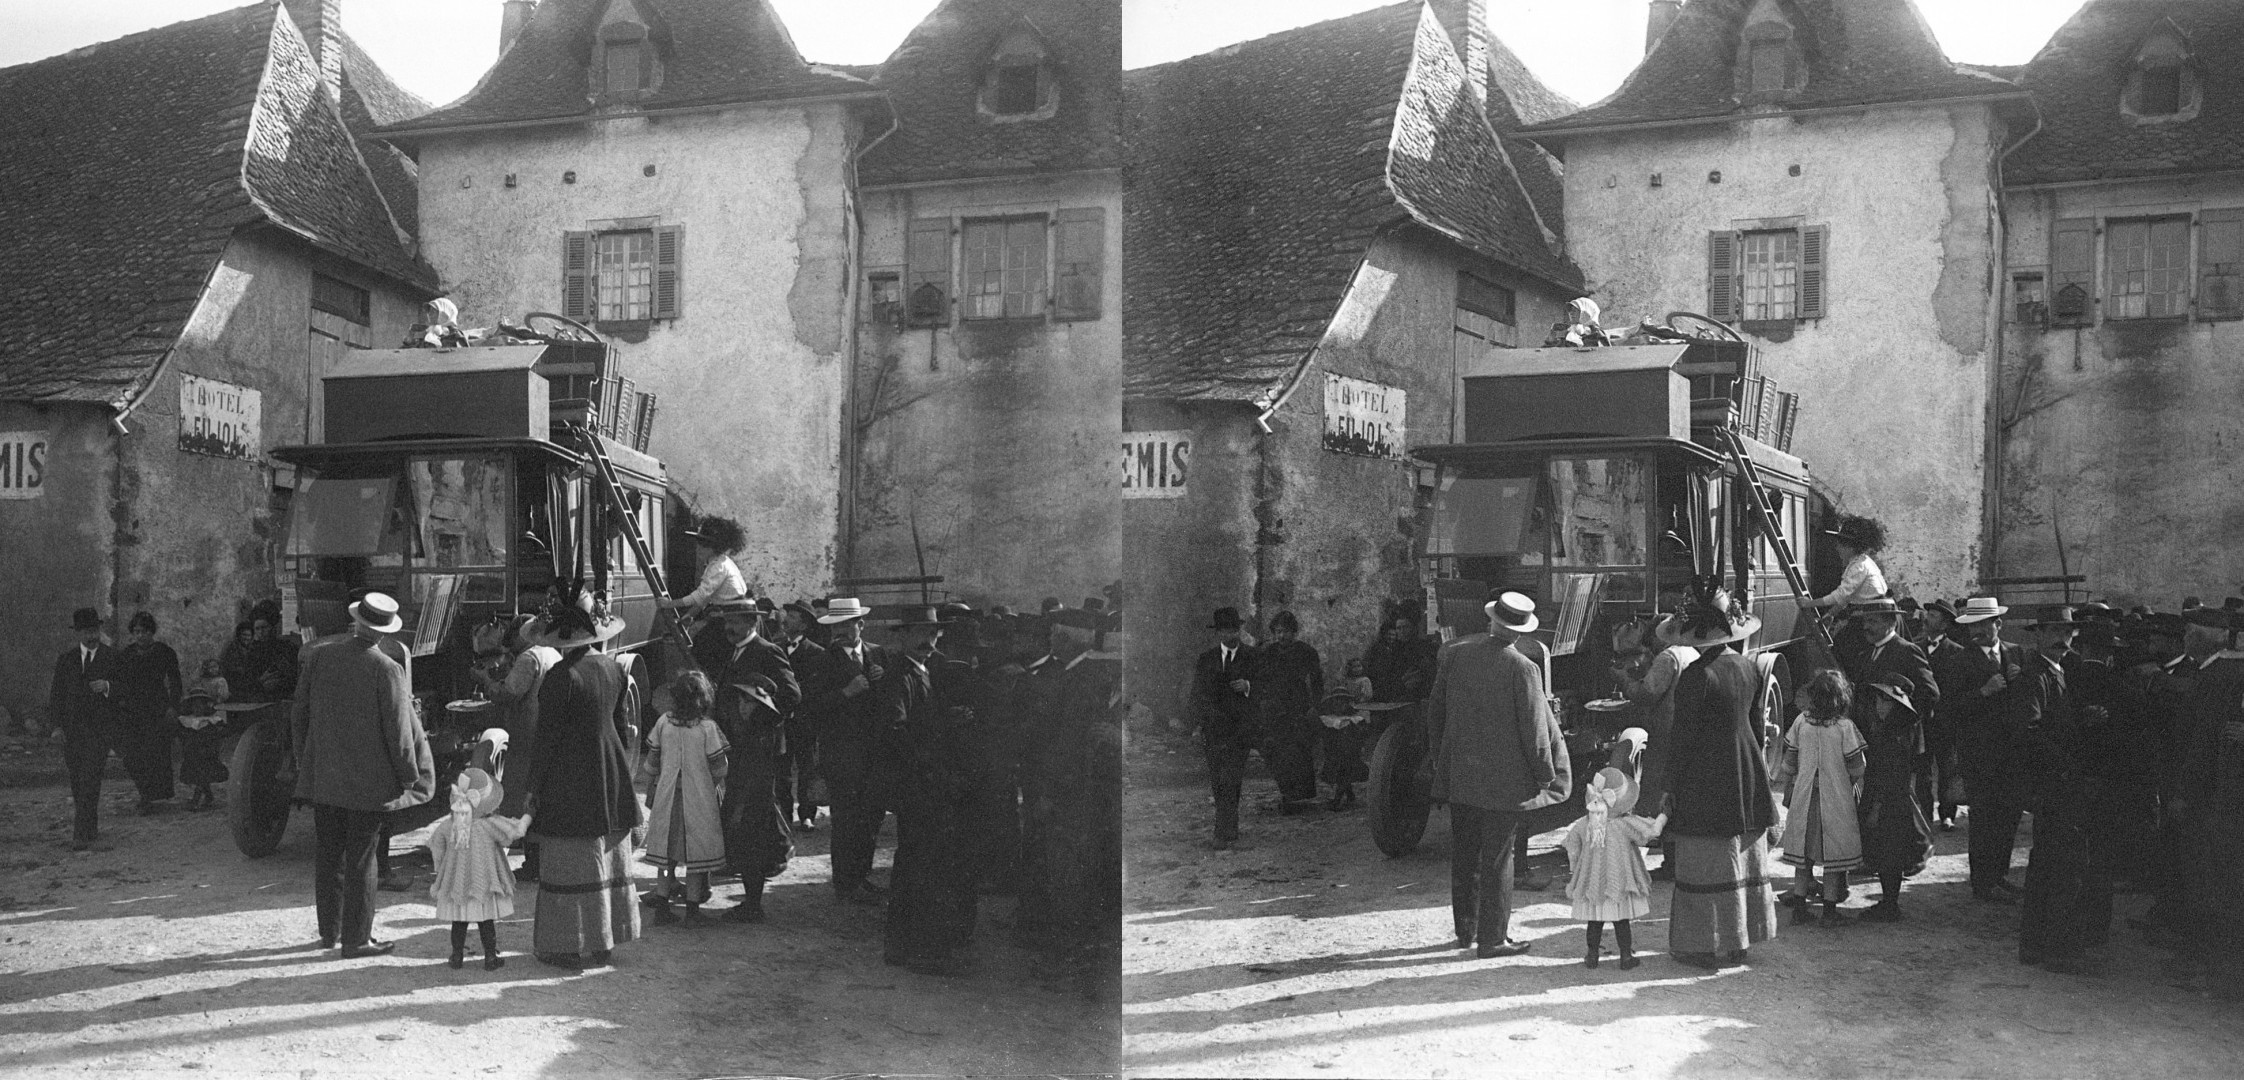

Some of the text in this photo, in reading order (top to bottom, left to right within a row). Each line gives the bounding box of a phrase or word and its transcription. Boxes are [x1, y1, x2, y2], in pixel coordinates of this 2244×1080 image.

[197, 386, 244, 415] HOTEL
[1342, 385, 1389, 414] HOTEL
[1122, 441, 1190, 488] EMIS
